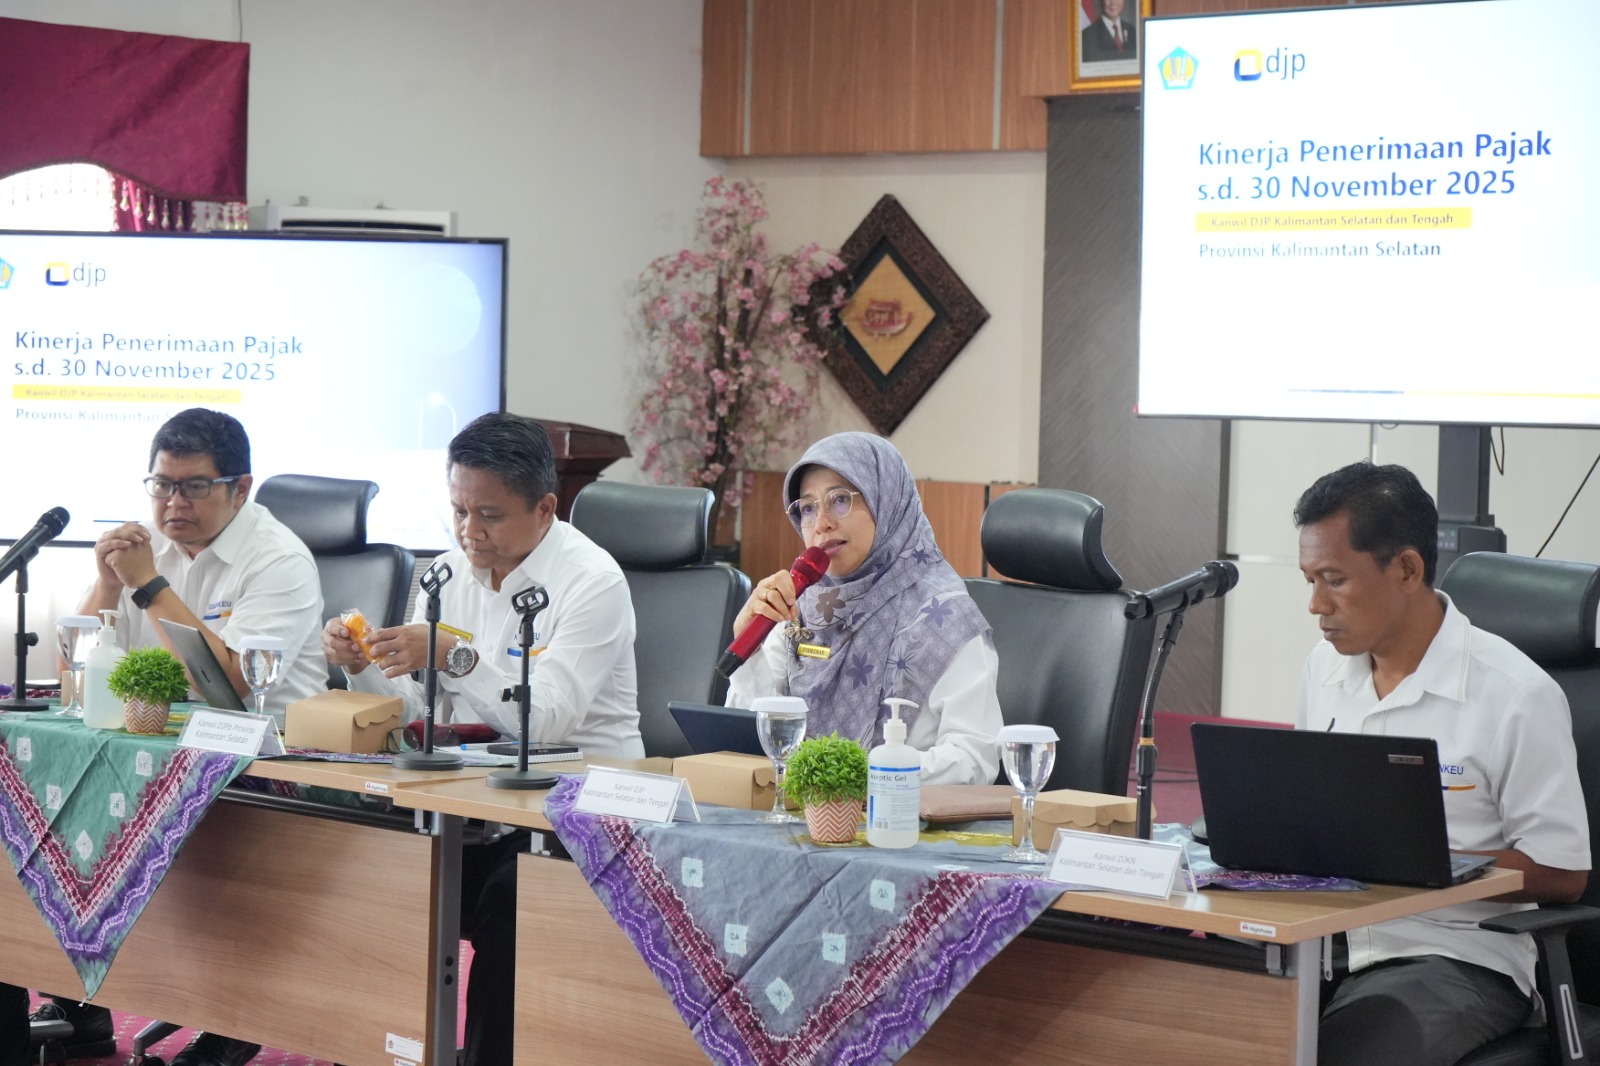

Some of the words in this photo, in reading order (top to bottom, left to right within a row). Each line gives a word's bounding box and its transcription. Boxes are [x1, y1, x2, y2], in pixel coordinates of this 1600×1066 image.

[1266, 47, 1306, 80] djp
[1198, 140, 1289, 171] Kinerja
[1300, 136, 1463, 162] Penerimaan
[1475, 130, 1551, 164] Pajak
[1198, 177, 1240, 200] s.d.
[1250, 176, 1281, 199] 30
[1291, 172, 1437, 198] November
[1446, 170, 1516, 196] 2025
[1211, 216, 1247, 227] Kanwil
[1250, 216, 1271, 227] DJP
[1274, 215, 1337, 226] Kalimantan
[1341, 214, 1382, 225] Selatan
[1386, 214, 1408, 225] dan
[1412, 213, 1453, 227] Tengah
[1199, 243, 1265, 258] Provinsi
[1271, 242, 1369, 257] Kalimantan
[1375, 241, 1441, 256] Selatan
[73, 262, 107, 287] djp
[15, 331, 93, 355] Kinerja
[102, 333, 235, 353] Penerimaan
[244, 336, 303, 359] Pajak
[14, 358, 51, 376] s.d.
[60, 358, 86, 376] 30
[95, 360, 213, 380] November
[222, 362, 276, 381] 2025
[26, 388, 57, 397] Kanwil
[16, 408, 72, 421] Provinsi
[78, 409, 159, 422] Kalimantan
[1094, 853, 1116, 861] Kanwil
[1059, 858, 1096, 870] Kalimantan
[1097, 862, 1123, 873] Selatan
[1123, 867, 1137, 875] dan
[1140, 868, 1165, 880] Tengah
